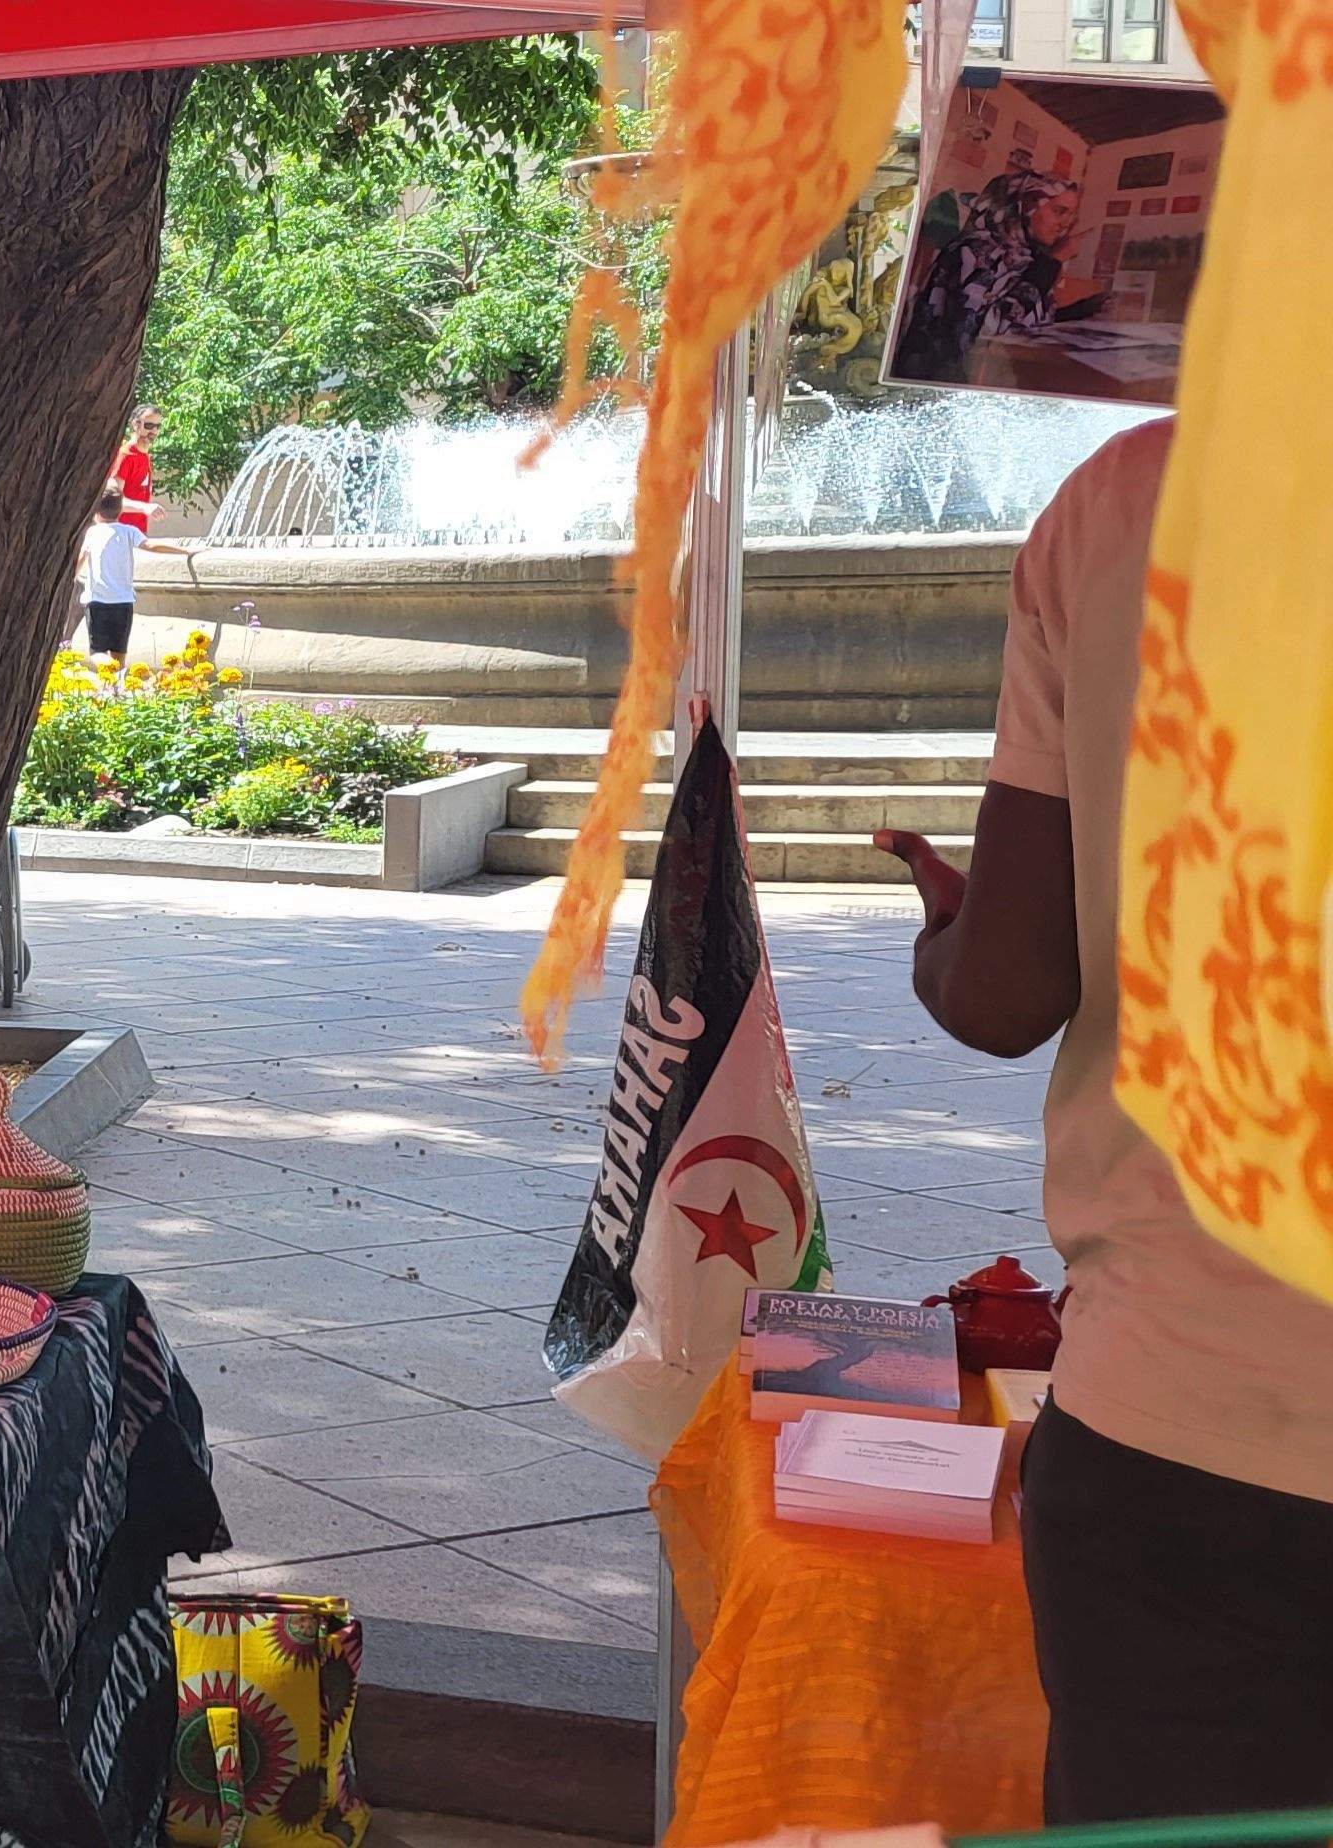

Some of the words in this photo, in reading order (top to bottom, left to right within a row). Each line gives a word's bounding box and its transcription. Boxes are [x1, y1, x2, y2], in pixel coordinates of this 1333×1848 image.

[769, 1297, 844, 1313] POETAS
[851, 1305, 864, 1313] Y
[797, 1308, 853, 1322] SAHARA
[855, 1314, 942, 1330] OCCIDENTAL
